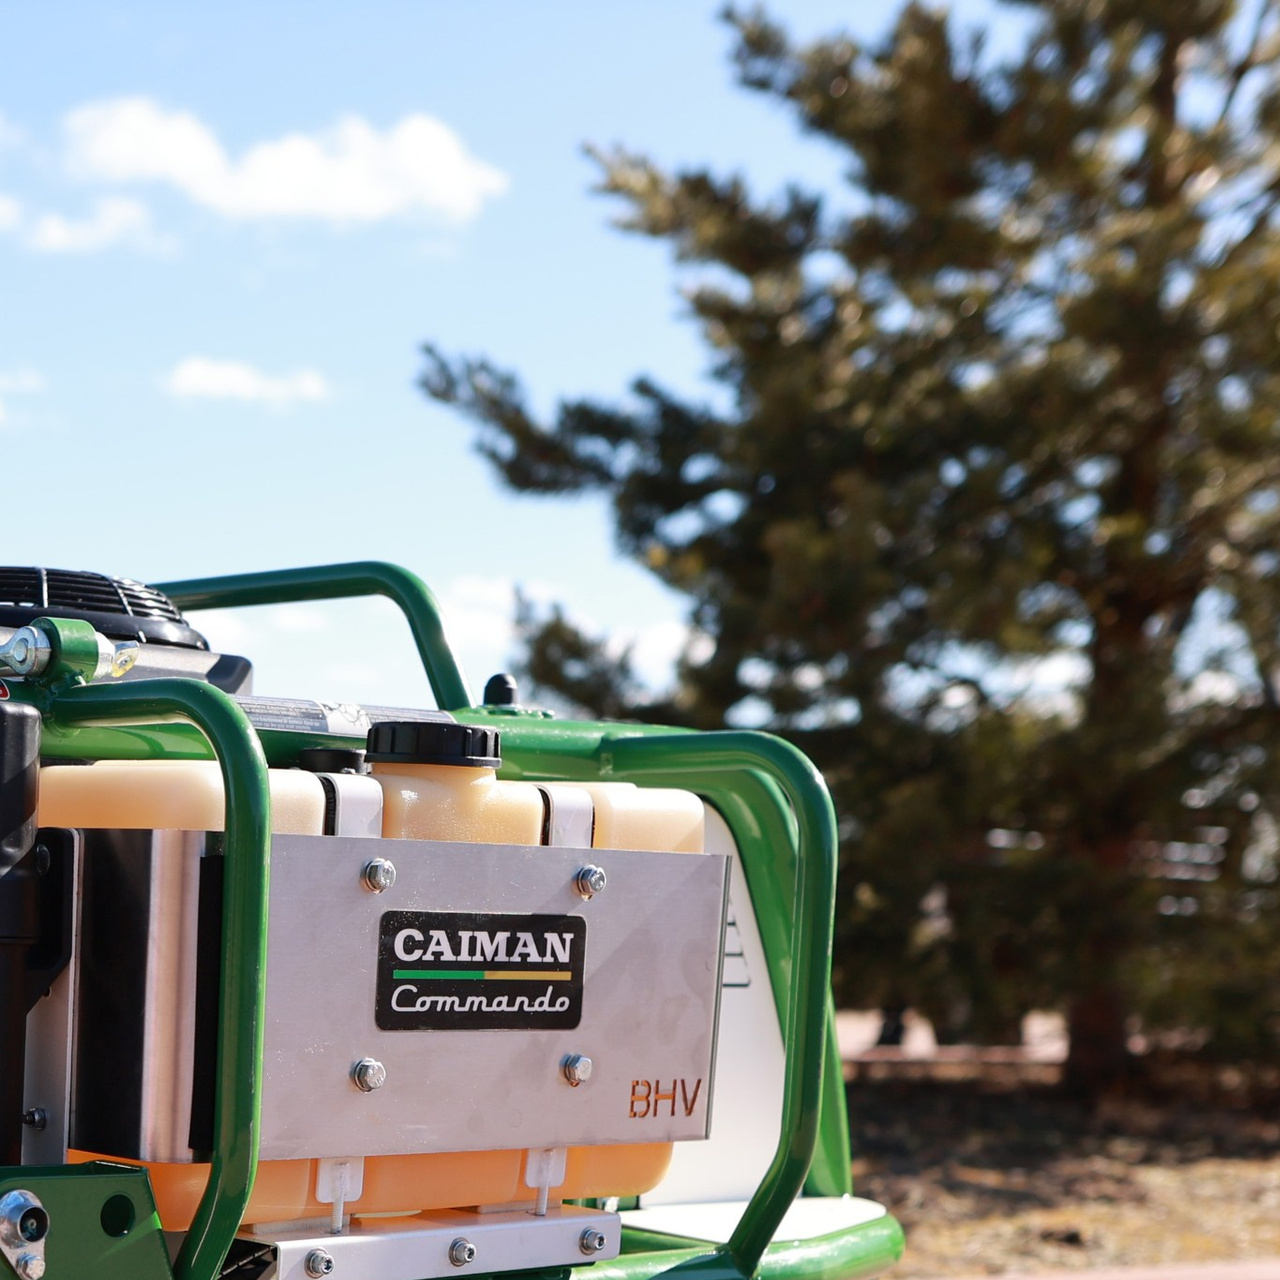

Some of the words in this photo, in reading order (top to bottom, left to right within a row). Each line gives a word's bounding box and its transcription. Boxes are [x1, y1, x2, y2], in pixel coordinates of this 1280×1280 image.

[393, 928, 575, 964] CAIMAN
[391, 984, 570, 1013] Commando
[628, 1078, 702, 1119] BHV
